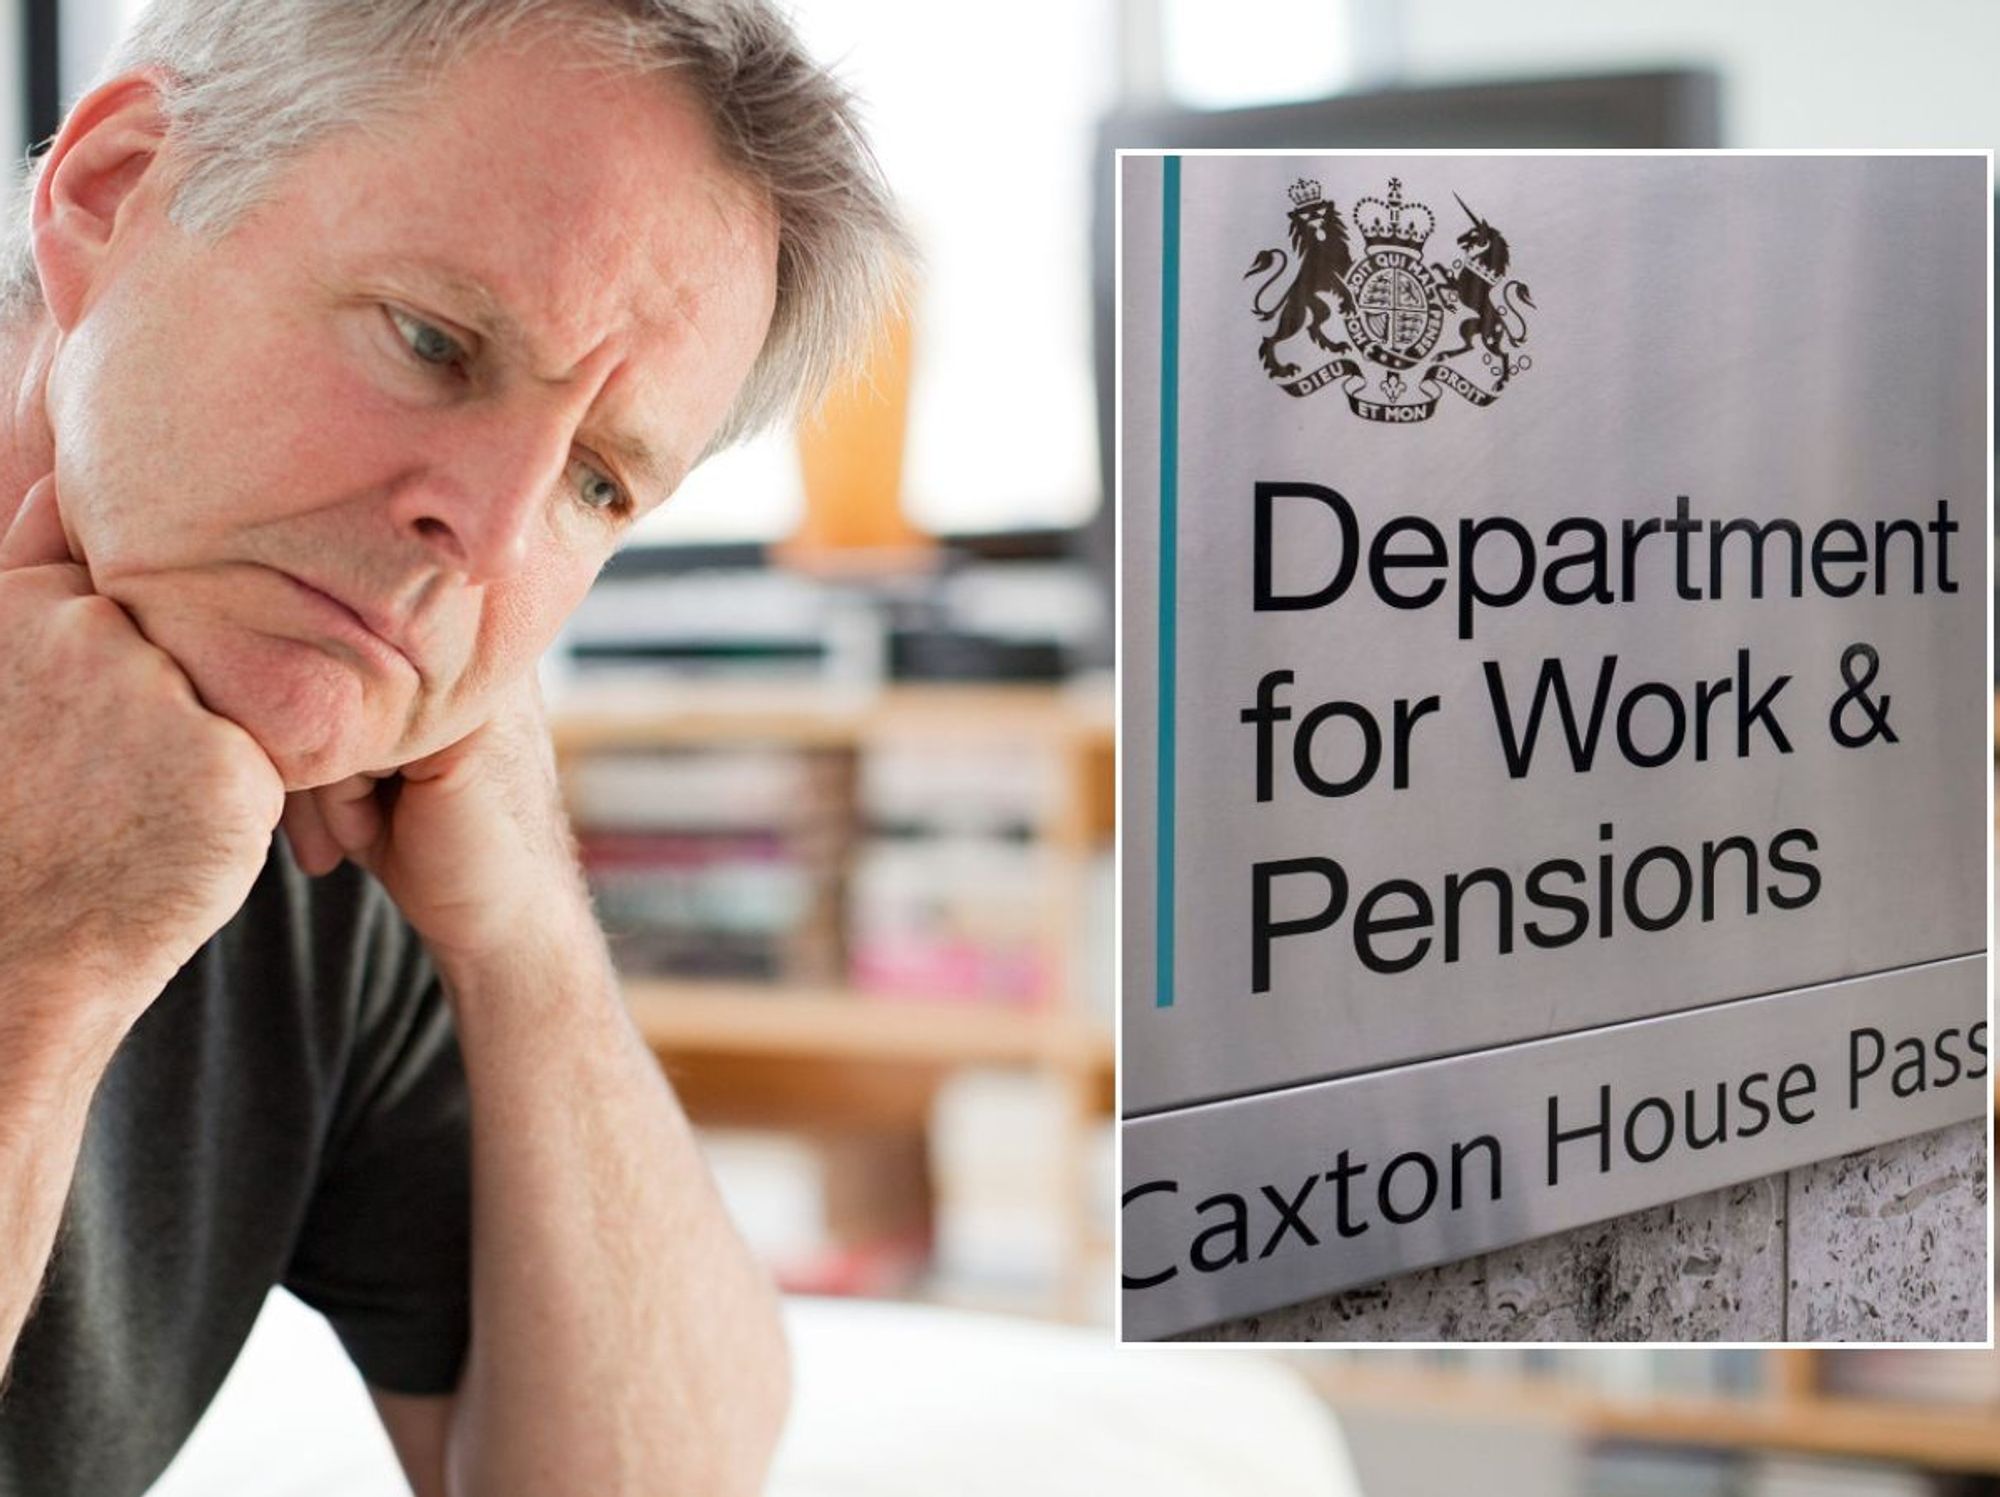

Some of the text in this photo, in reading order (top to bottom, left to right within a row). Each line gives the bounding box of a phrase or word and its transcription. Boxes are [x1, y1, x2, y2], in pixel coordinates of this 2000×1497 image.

[1375, 253, 1406, 269] QUI
[1408, 260, 1438, 297] MAL
[1414, 310, 1442, 357] PENSE
[1299, 361, 1486, 422] DIEU ET MON DROIT
[1252, 480, 1959, 639] Department
[1240, 642, 1899, 803] for Work &
[1251, 822, 1822, 993] Pensions
[1122, 1021, 1987, 1290] Caxton House Pass
